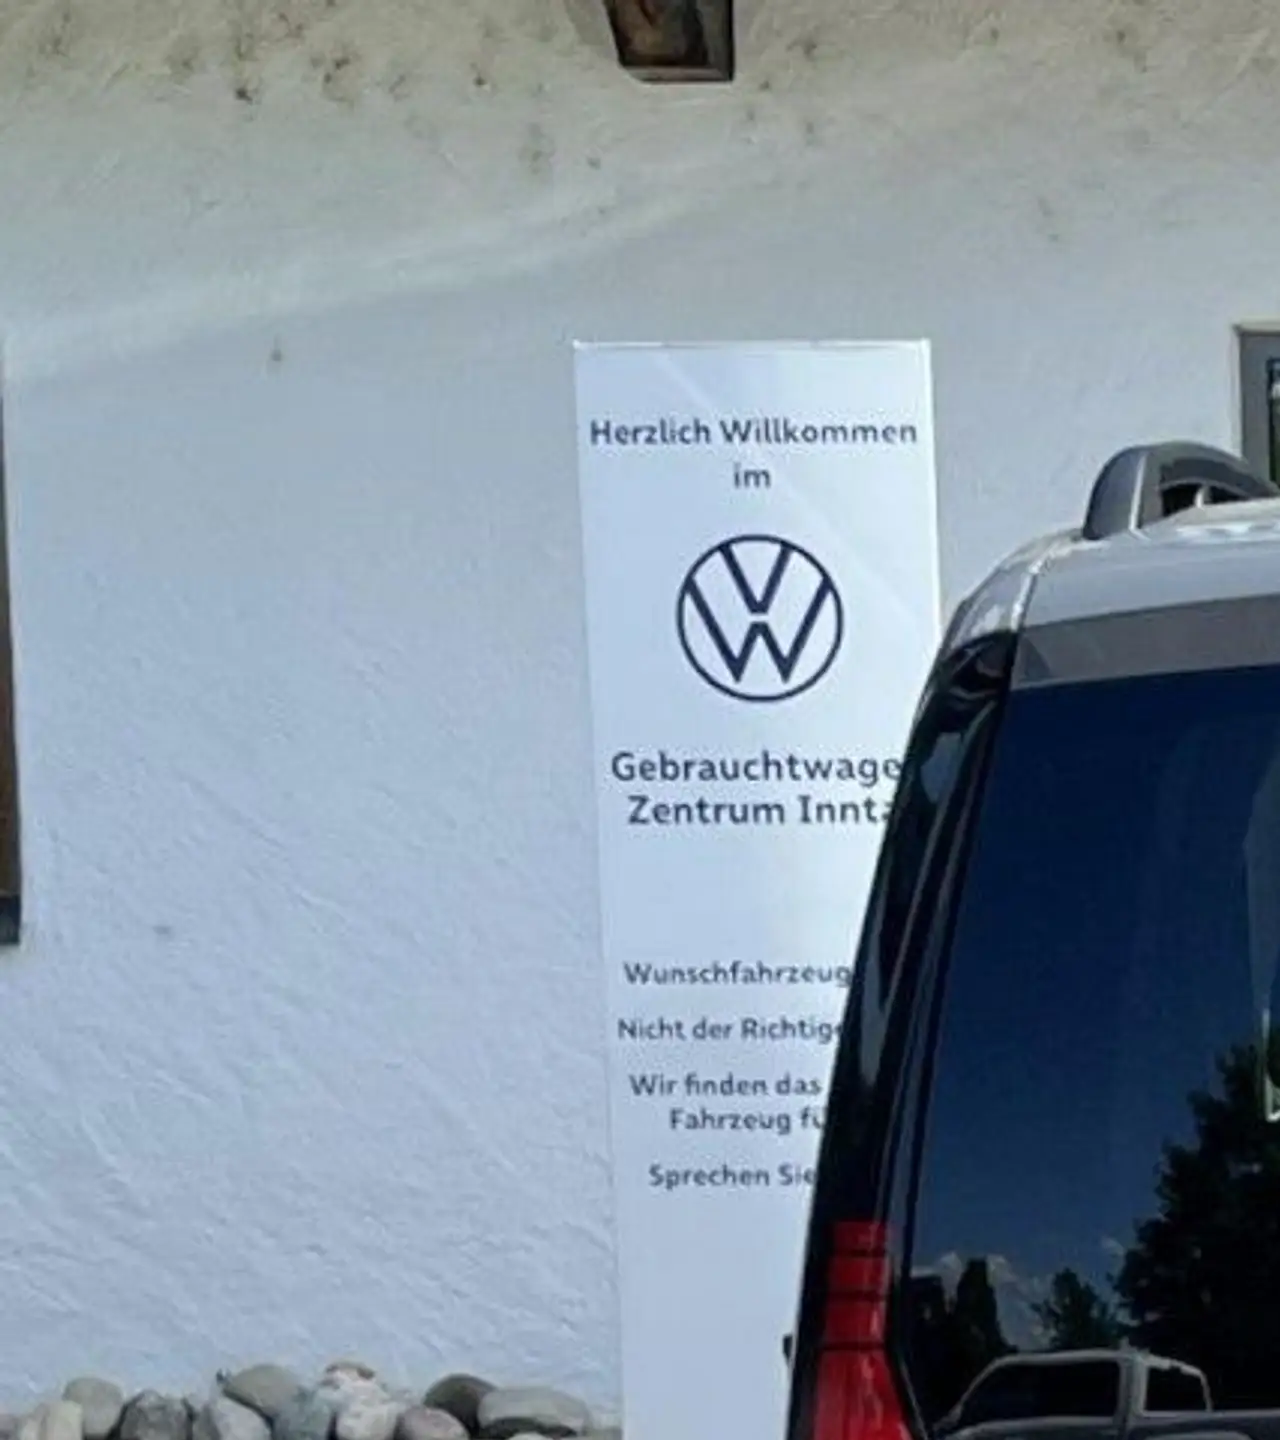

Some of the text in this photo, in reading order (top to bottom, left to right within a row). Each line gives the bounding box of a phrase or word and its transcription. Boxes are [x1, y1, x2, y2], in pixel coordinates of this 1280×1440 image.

[590, 419, 918, 446] Herzlich Willkommen
[733, 462, 772, 488] im
[676, 533, 844, 703] VW
[611, 750, 902, 788] Gebrauchtwage
[627, 794, 786, 826] Zentrum
[623, 961, 853, 988] Wunschfahrzeug
[617, 1018, 685, 1041] Nicht
[692, 1018, 732, 1040] der
[629, 1072, 823, 1097] Wir finden das
[669, 1107, 791, 1136] Fahrzeug
[648, 1163, 770, 1189] Sprechen
